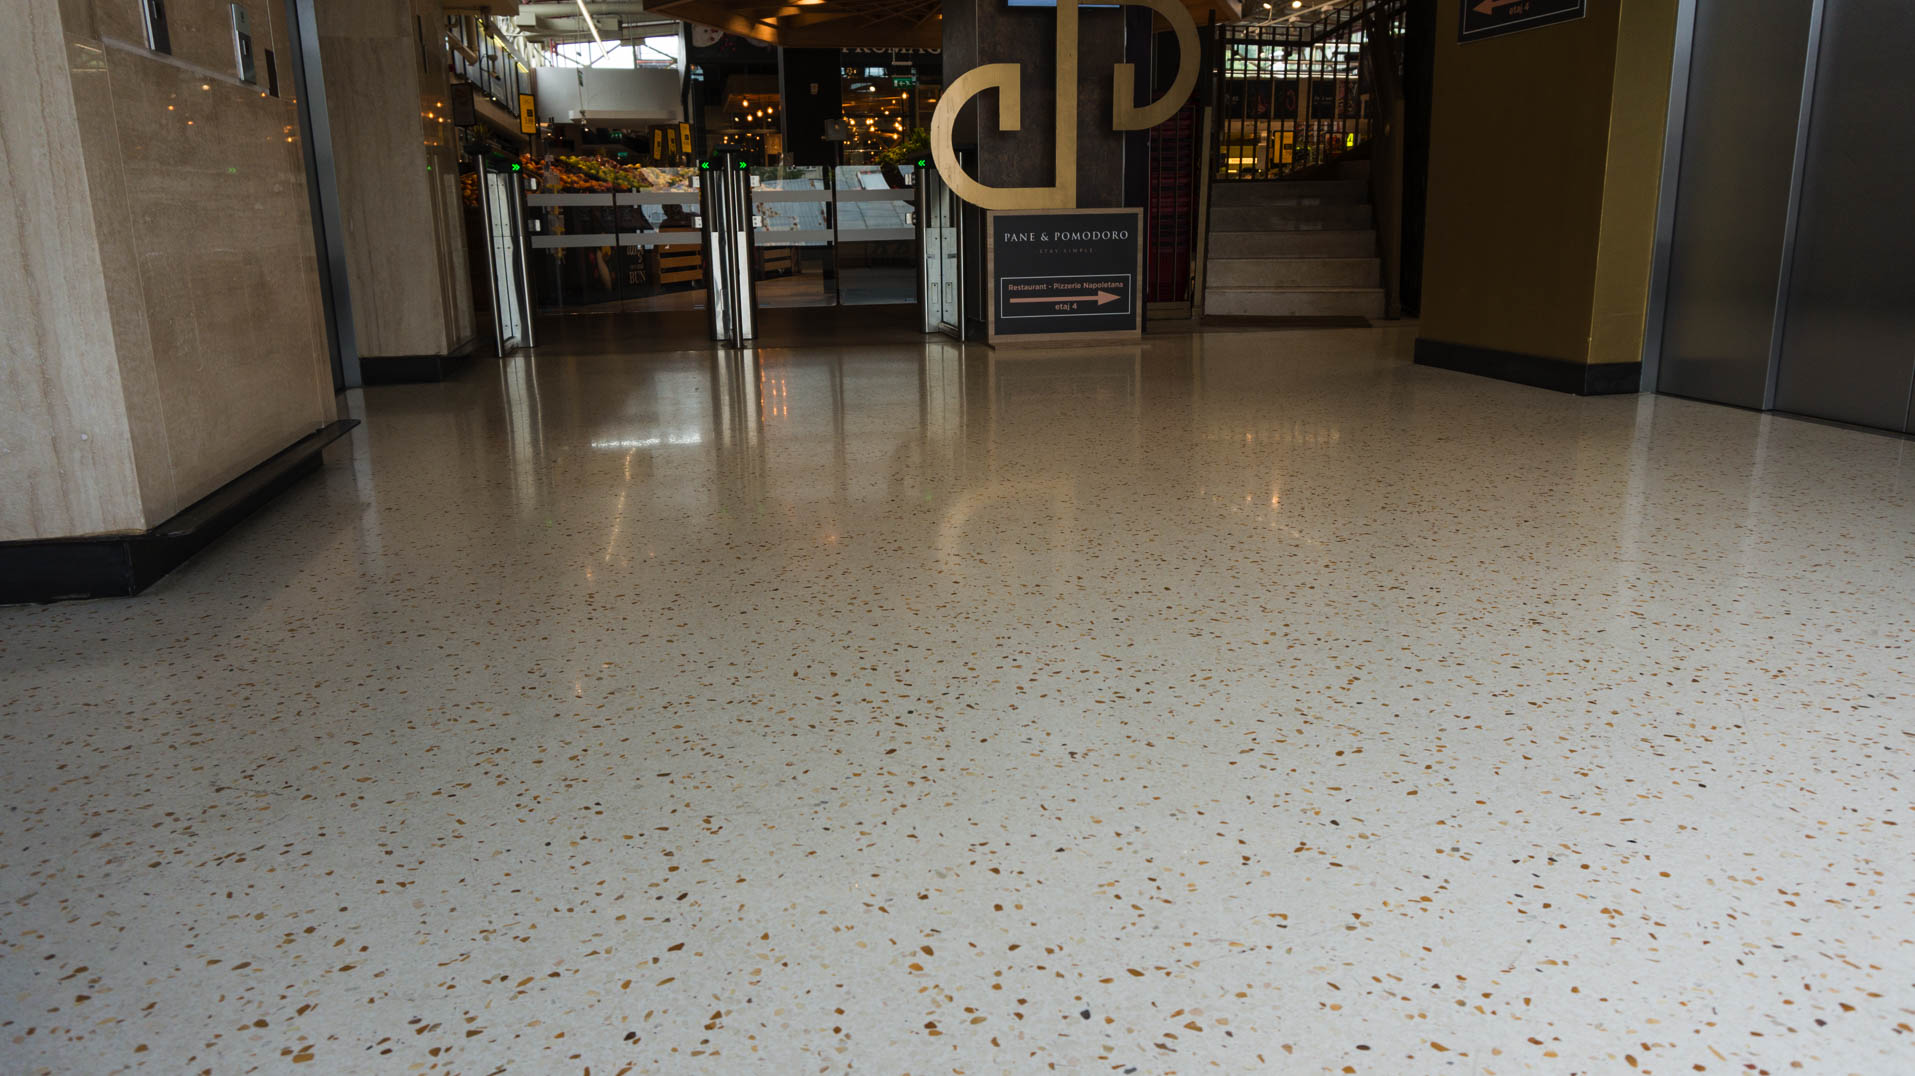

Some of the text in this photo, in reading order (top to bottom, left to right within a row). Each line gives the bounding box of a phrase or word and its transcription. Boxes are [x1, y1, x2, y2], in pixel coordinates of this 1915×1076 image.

[1004, 230, 1129, 243] PANE & POMODORO
[1083, 281, 1124, 290] Napoletana
[1055, 302, 1078, 311] etaj 4
